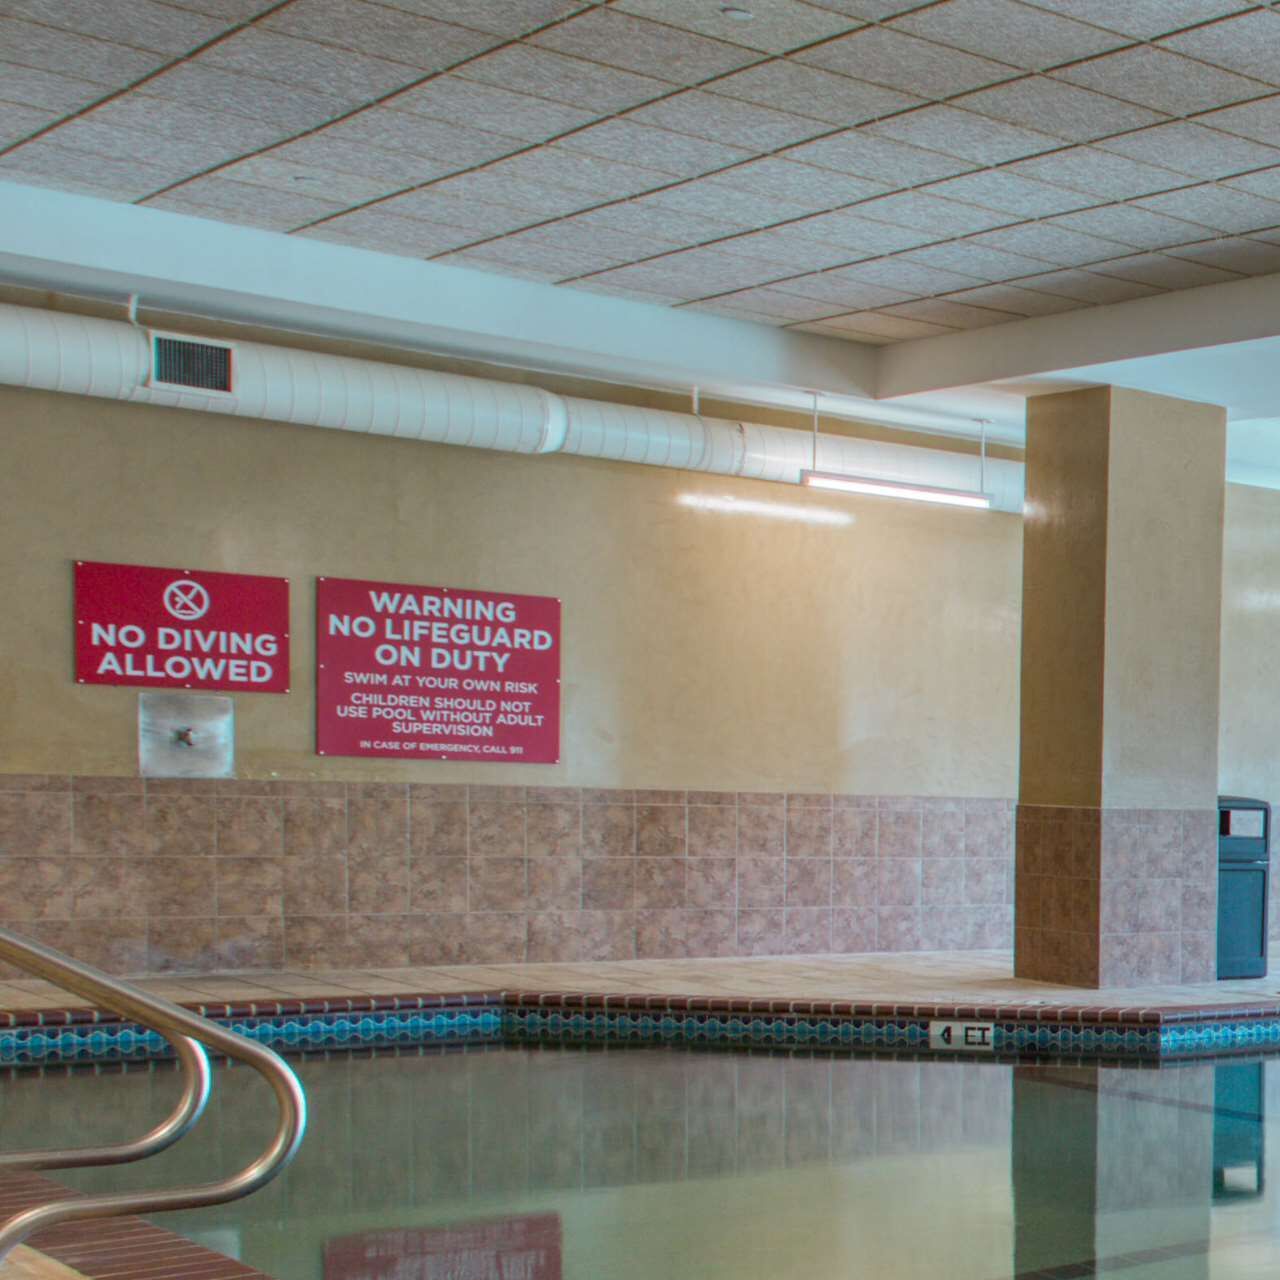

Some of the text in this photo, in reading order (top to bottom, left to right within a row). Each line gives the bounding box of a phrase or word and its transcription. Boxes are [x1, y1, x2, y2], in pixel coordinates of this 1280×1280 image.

[368, 590, 517, 624] WARNING
[91, 623, 279, 657] NO DIVING
[328, 613, 553, 651] NO LIFEGUARD
[96, 652, 273, 683] ALLOWED
[374, 643, 511, 673] ON DUTY
[344, 671, 539, 695] SWIM AT YOUR OWN RISK
[336, 705, 544, 727] USE POOL WITHOUT ADULT
[351, 692, 532, 713] CHILDREN SHOULD NOT
[392, 721, 494, 737] SUPERVISION
[360, 740, 371, 749] IN
[373, 740, 401, 750] CASE
[402, 742, 418, 750] OF
[482, 744, 508, 754] CALL
[510, 745, 524, 755] 911
